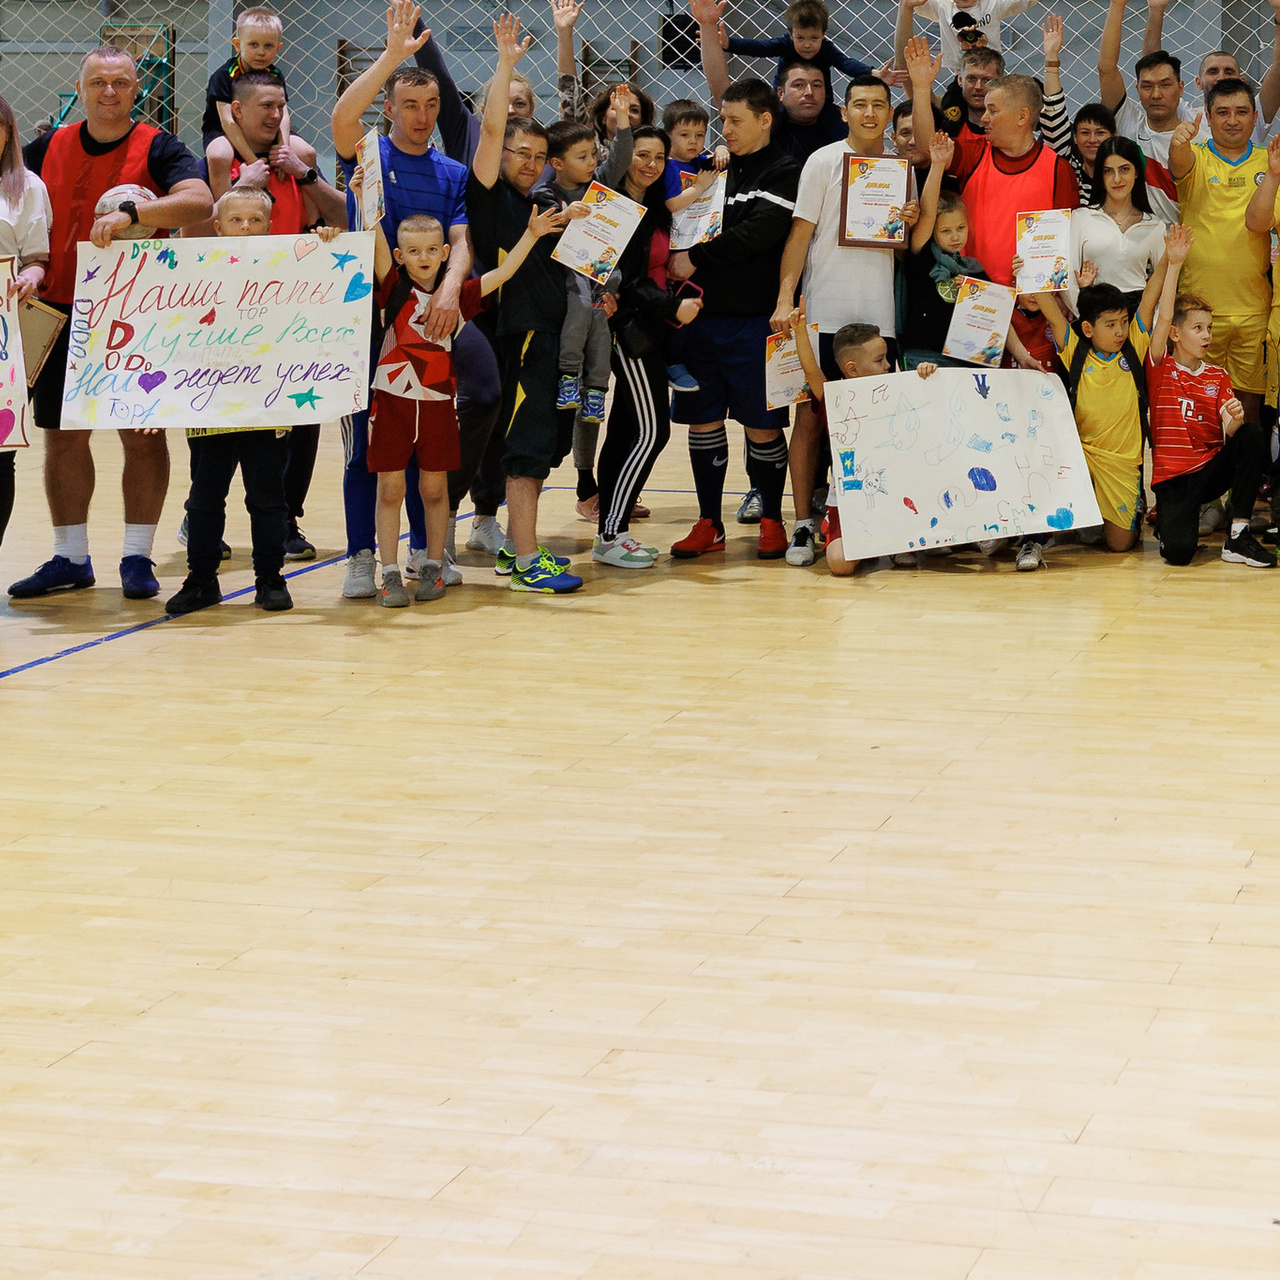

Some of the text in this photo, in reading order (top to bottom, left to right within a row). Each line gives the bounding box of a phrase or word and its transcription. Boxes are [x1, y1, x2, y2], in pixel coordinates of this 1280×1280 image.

[88, 252, 337, 328] Наши папы
[122, 322, 264, 367] Лучше
[173, 367, 262, 412] ждет
[265, 362, 350, 408] успех
